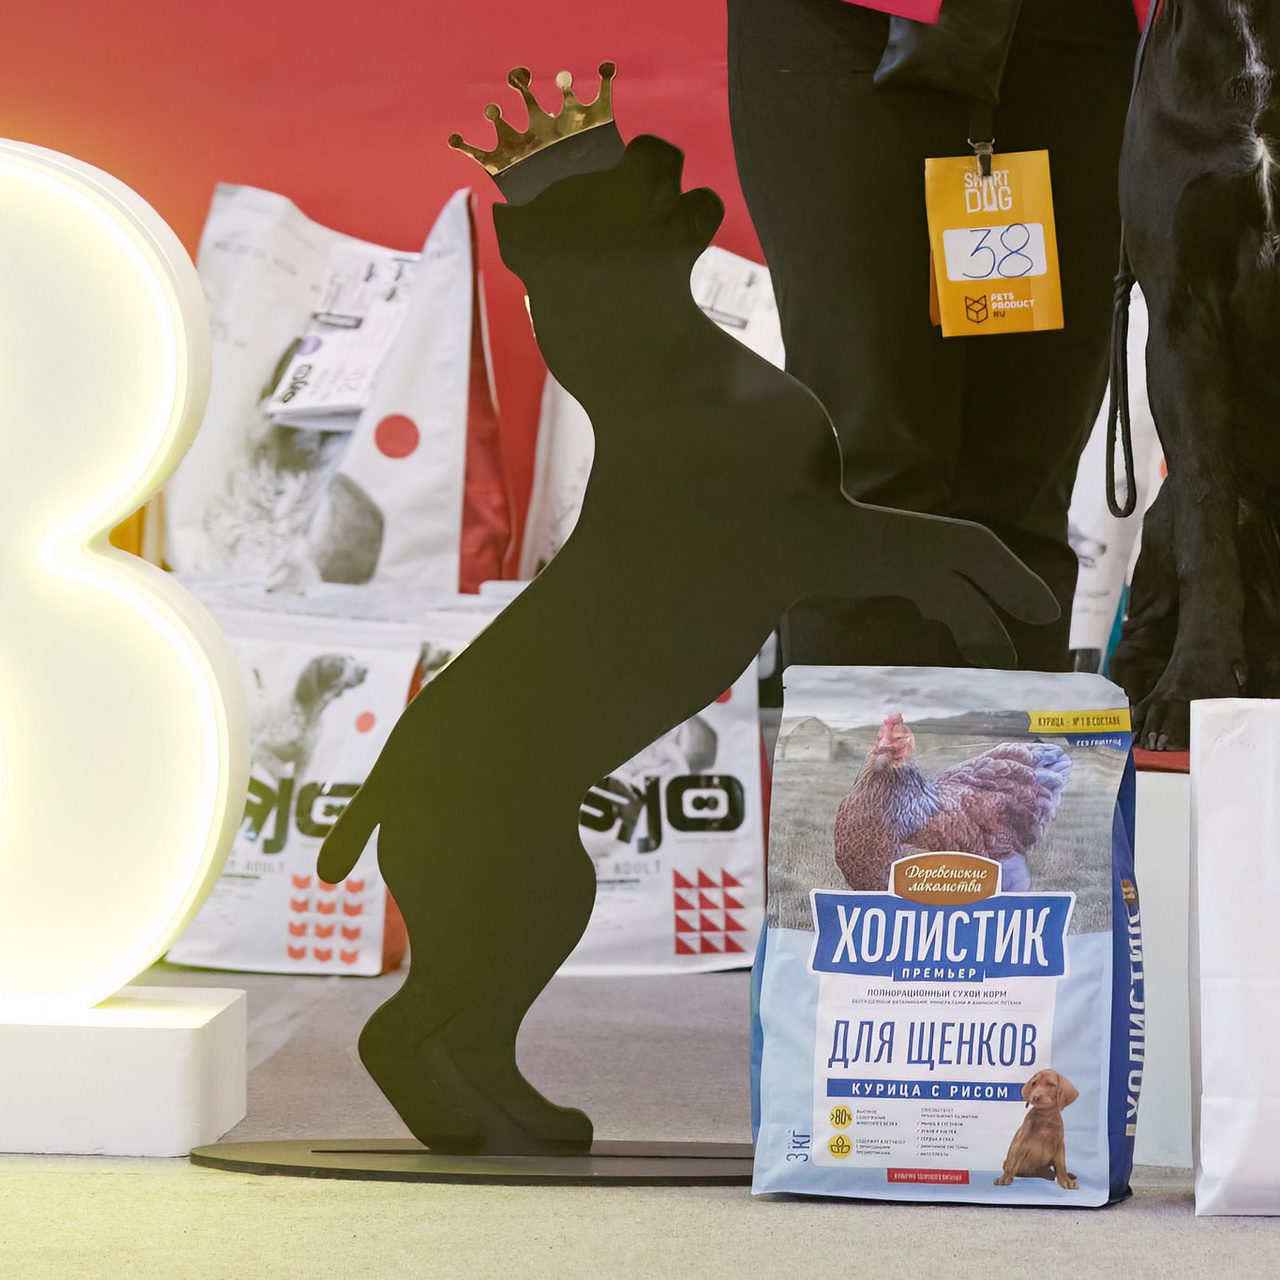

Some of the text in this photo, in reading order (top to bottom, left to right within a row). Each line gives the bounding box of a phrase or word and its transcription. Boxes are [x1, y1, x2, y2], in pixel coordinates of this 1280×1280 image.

[962, 223, 1034, 278] 38
[990, 293, 1014, 302] PETS
[991, 299, 1035, 309] PRODUCT
[1038, 717, 1064, 727] КУРИЦА
[905, 865, 987, 880] Деревенские
[908, 881, 982, 892] лакомства
[831, 905, 1050, 967] ХОЛИСТИК
[902, 968, 977, 979] ПРЕМЬЕР
[867, 988, 1007, 999] ПОЛНОРАЦИОННЫЙ СУХОЙ КОРМ
[828, 1020, 1037, 1070] ДЛЯ ЩЕНКОВ
[852, 1082, 1008, 1098] КУРИЦА С РИСОМ
[786, 1130, 811, 1163] 3 КГ
